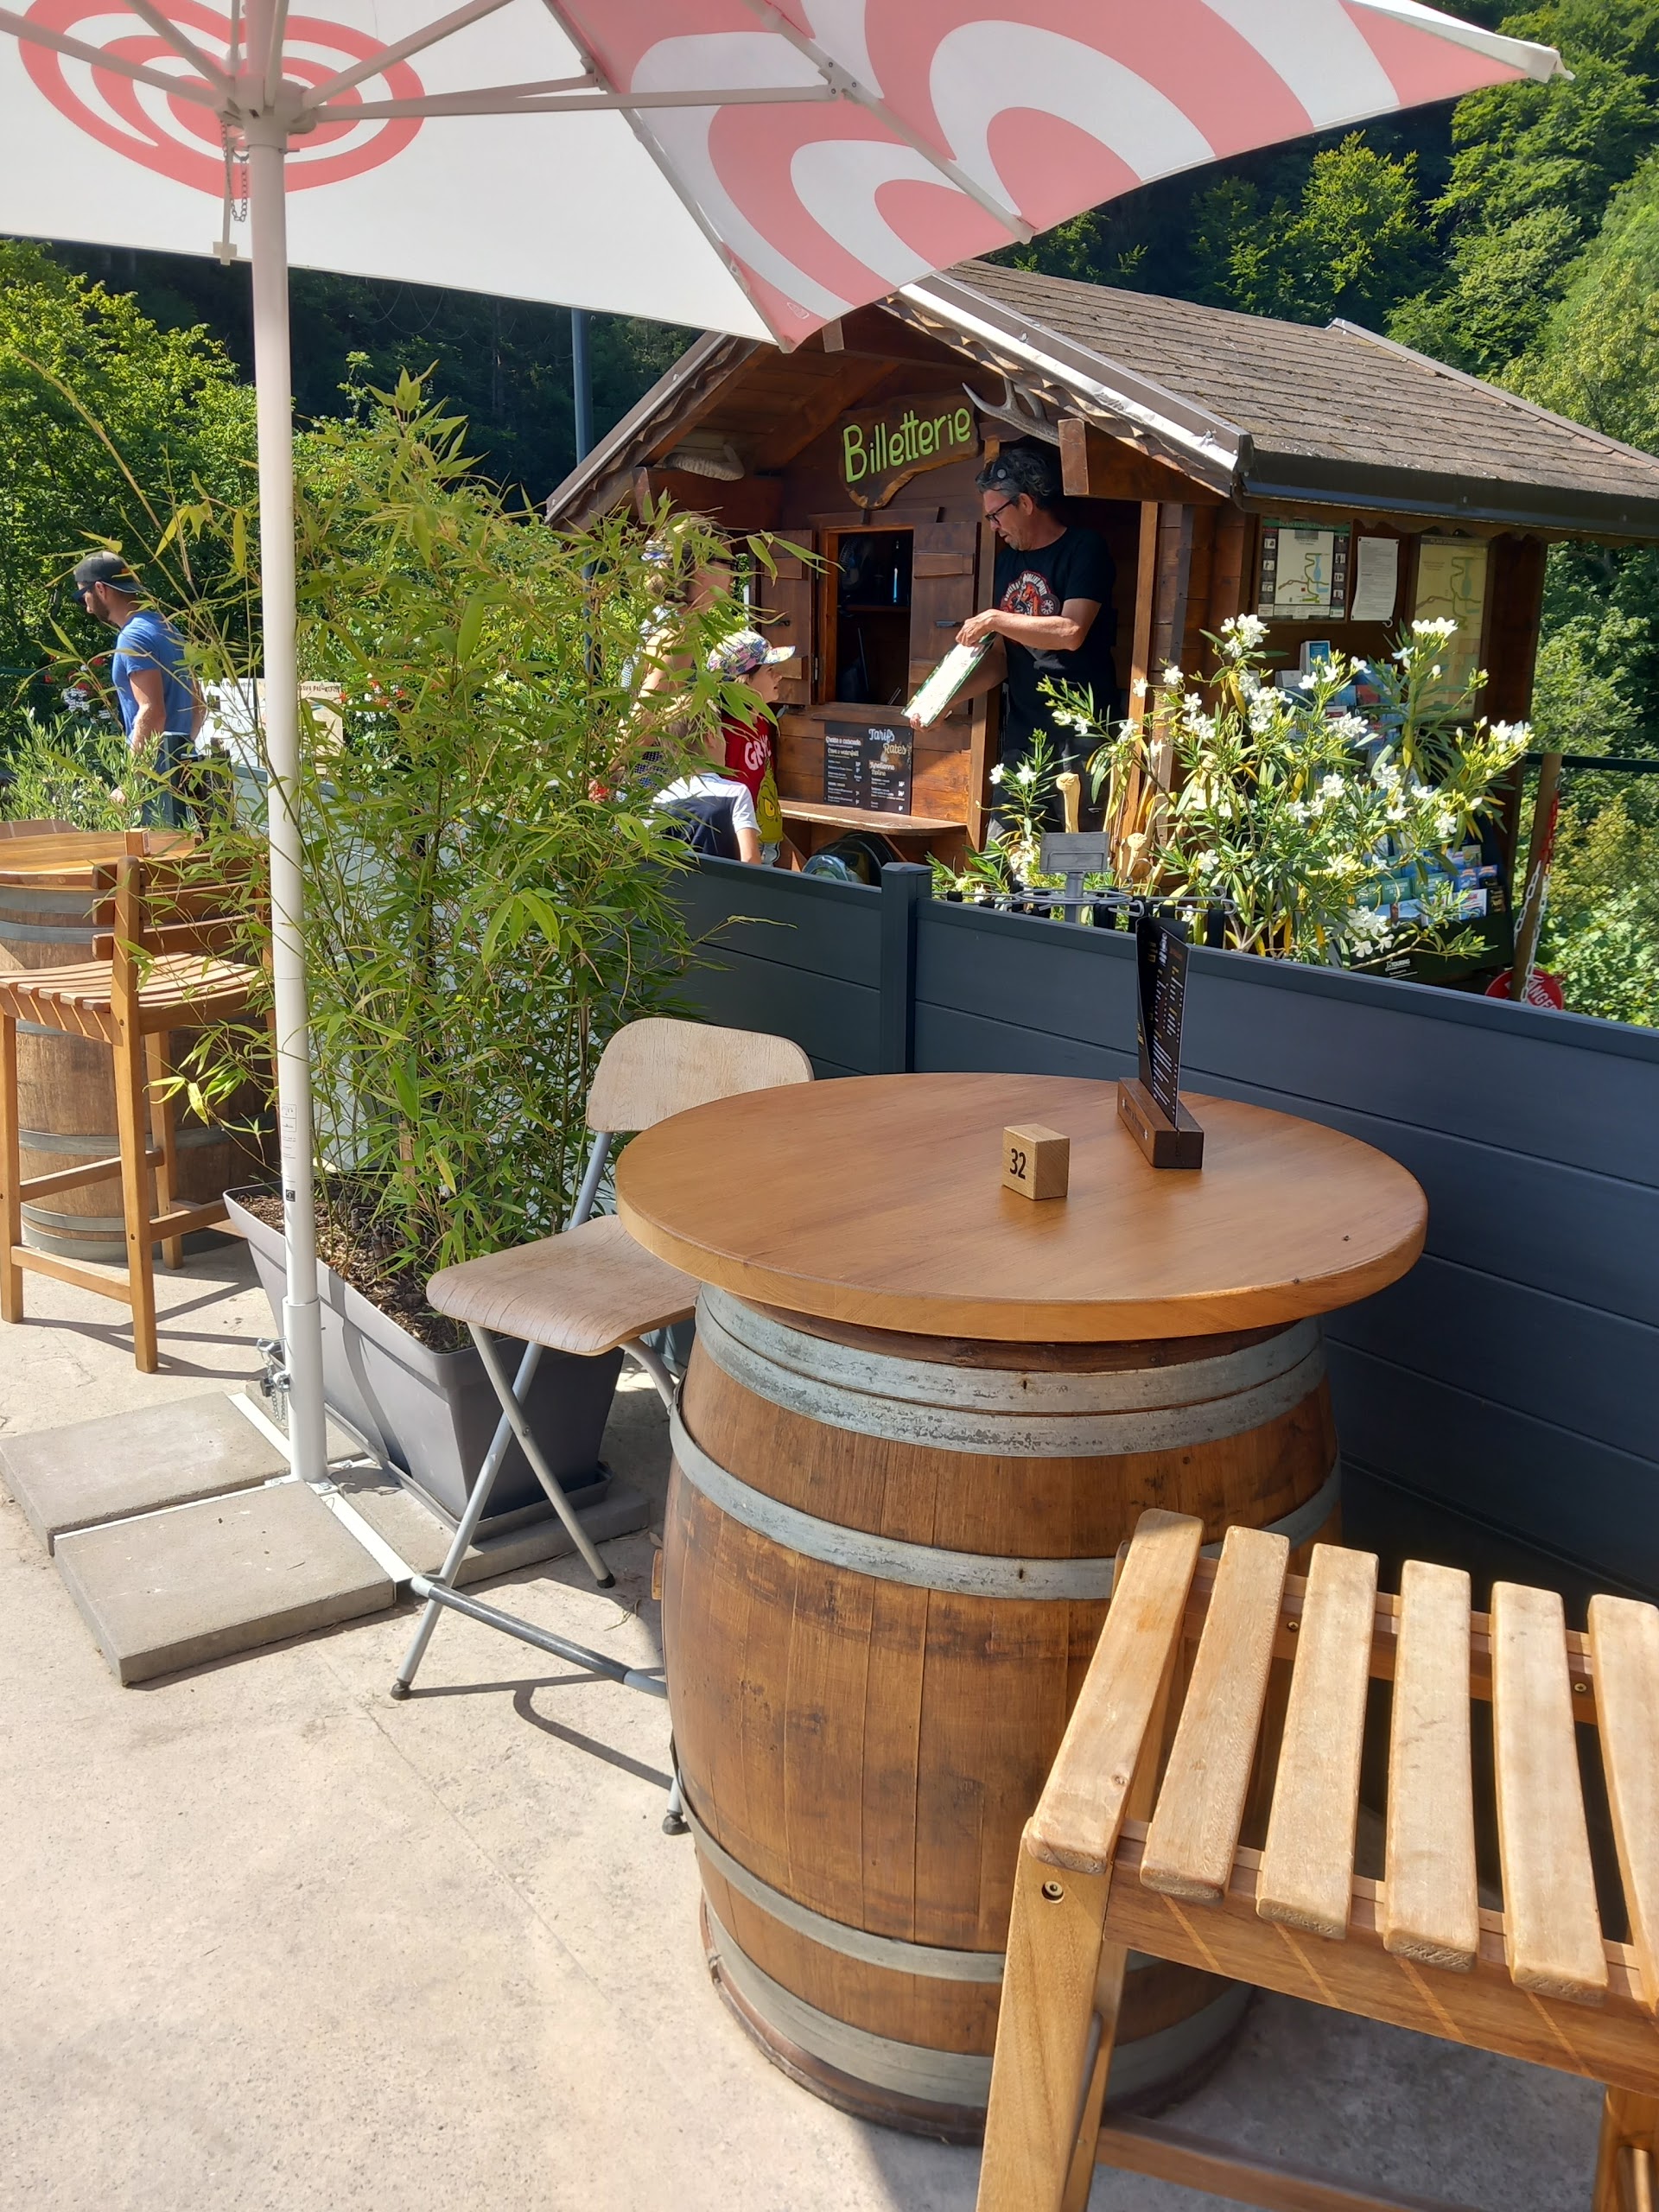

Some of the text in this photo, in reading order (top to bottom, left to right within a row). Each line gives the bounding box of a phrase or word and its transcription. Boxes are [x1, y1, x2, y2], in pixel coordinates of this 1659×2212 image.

[843, 408, 970, 483] Billetterie
[868, 728, 895, 743] Tarifs
[882, 743, 907, 755] Rates
[1010, 1147, 1027, 1179] 32
